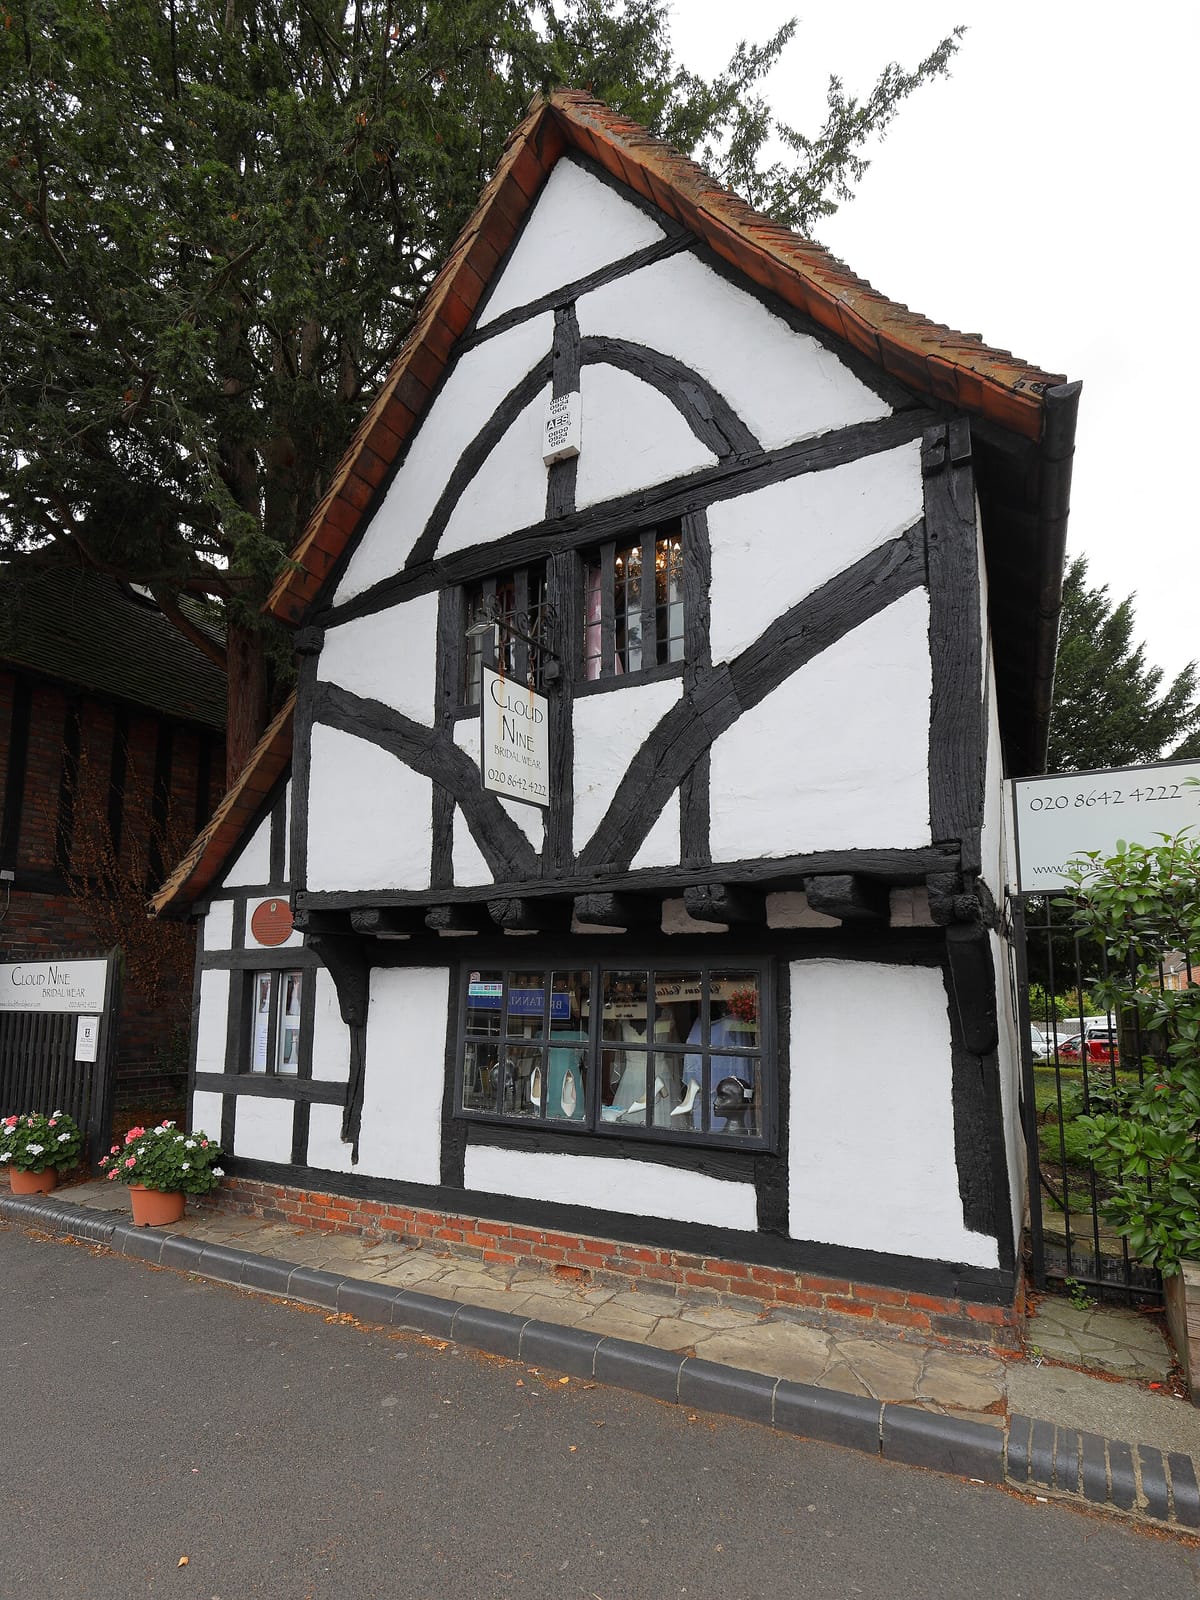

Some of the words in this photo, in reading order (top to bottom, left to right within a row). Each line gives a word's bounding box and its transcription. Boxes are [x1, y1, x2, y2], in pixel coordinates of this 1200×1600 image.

[547, 413, 570, 431] AES
[494, 744, 522, 763] BRIDAL
[521, 755, 541, 770] WEAR
[488, 768, 506, 784] 020
[507, 775, 528, 791] 8642
[528, 781, 547, 797] 4222
[1030, 795, 1069, 812] 020
[1074, 789, 1125, 808] 8642
[1129, 784, 1182, 803] 4222
[42, 988, 65, 998] BRIDAL
[66, 988, 86, 998] WEAR
